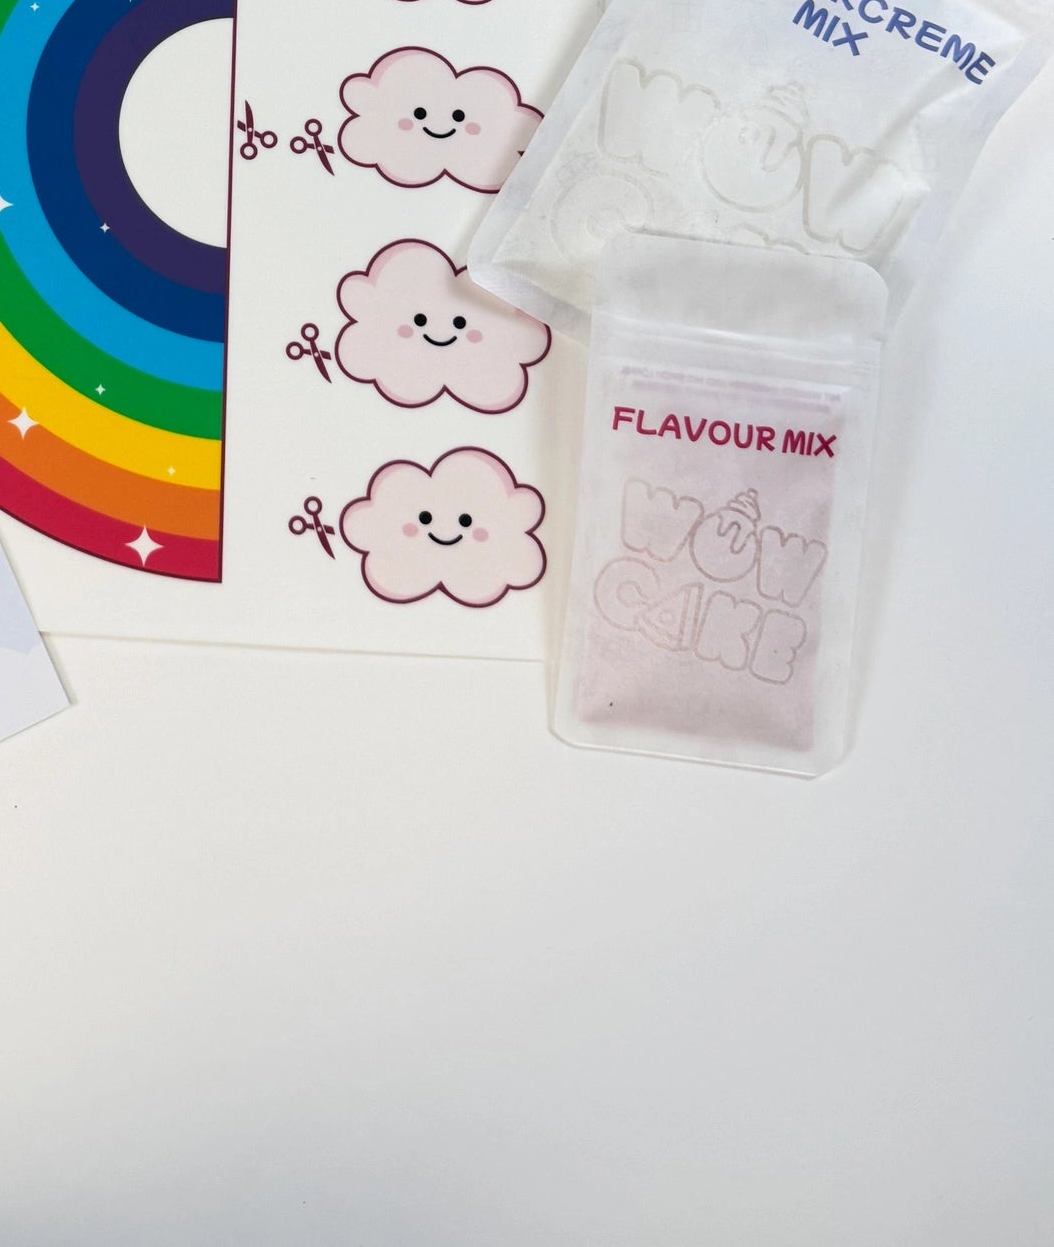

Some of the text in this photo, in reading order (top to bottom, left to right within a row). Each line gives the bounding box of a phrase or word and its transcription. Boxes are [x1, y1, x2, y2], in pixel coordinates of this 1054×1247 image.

[612, 406, 838, 458] FLAVOUR MIX
[620, 477, 829, 607] WOW
